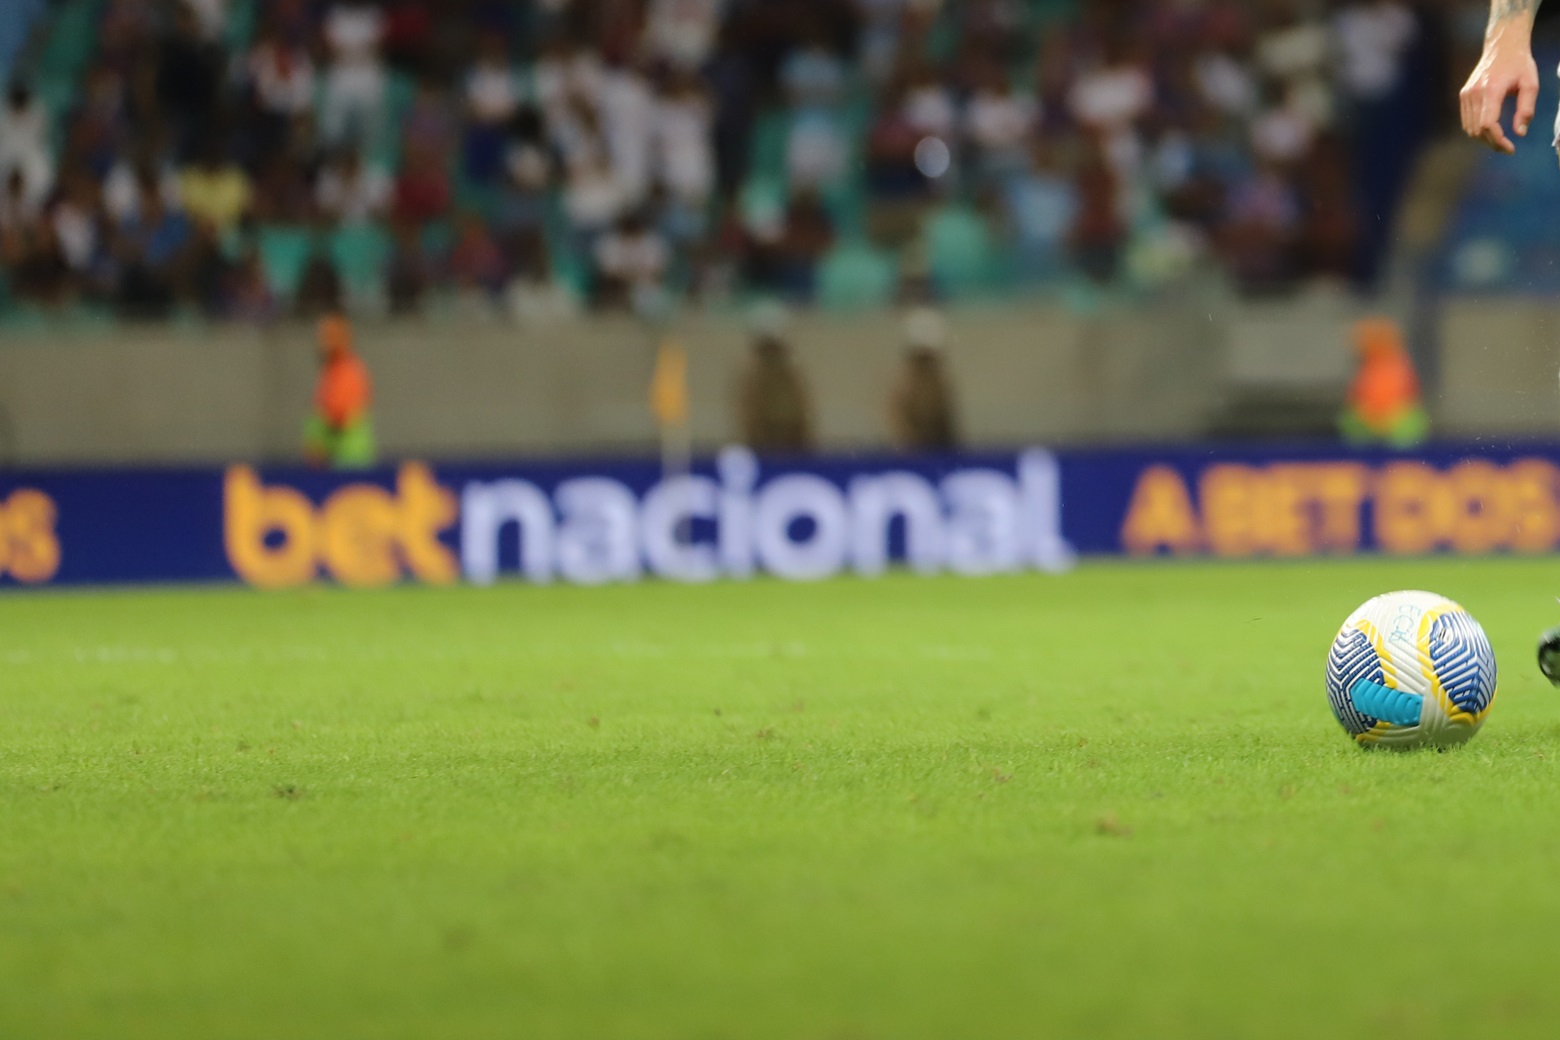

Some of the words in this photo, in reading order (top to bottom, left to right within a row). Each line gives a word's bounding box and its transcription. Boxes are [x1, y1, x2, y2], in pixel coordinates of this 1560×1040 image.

[222, 446, 1074, 588] betnacional
[1124, 463, 1197, 554] A
[1201, 459, 1369, 554] BET
[1374, 457, 1558, 552] DOS
